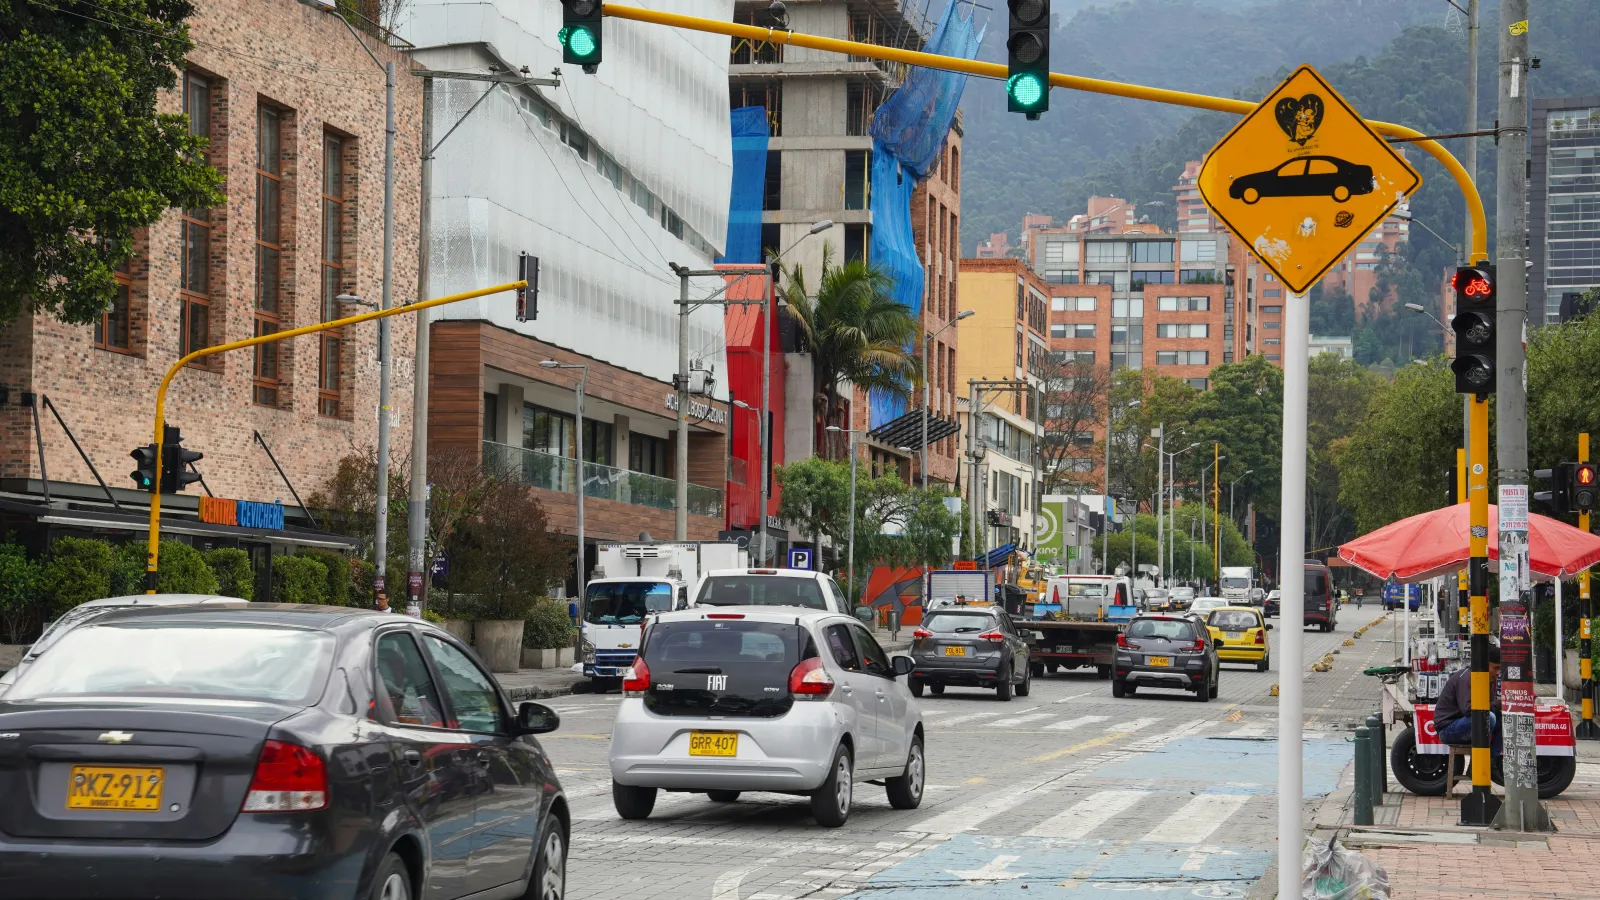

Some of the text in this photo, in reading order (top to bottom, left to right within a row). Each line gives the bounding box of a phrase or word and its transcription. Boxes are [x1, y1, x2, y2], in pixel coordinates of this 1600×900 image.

[200, 496, 238, 526] CENTRAL
[793, 552, 807, 567] P
[706, 675, 729, 691] FIAT
